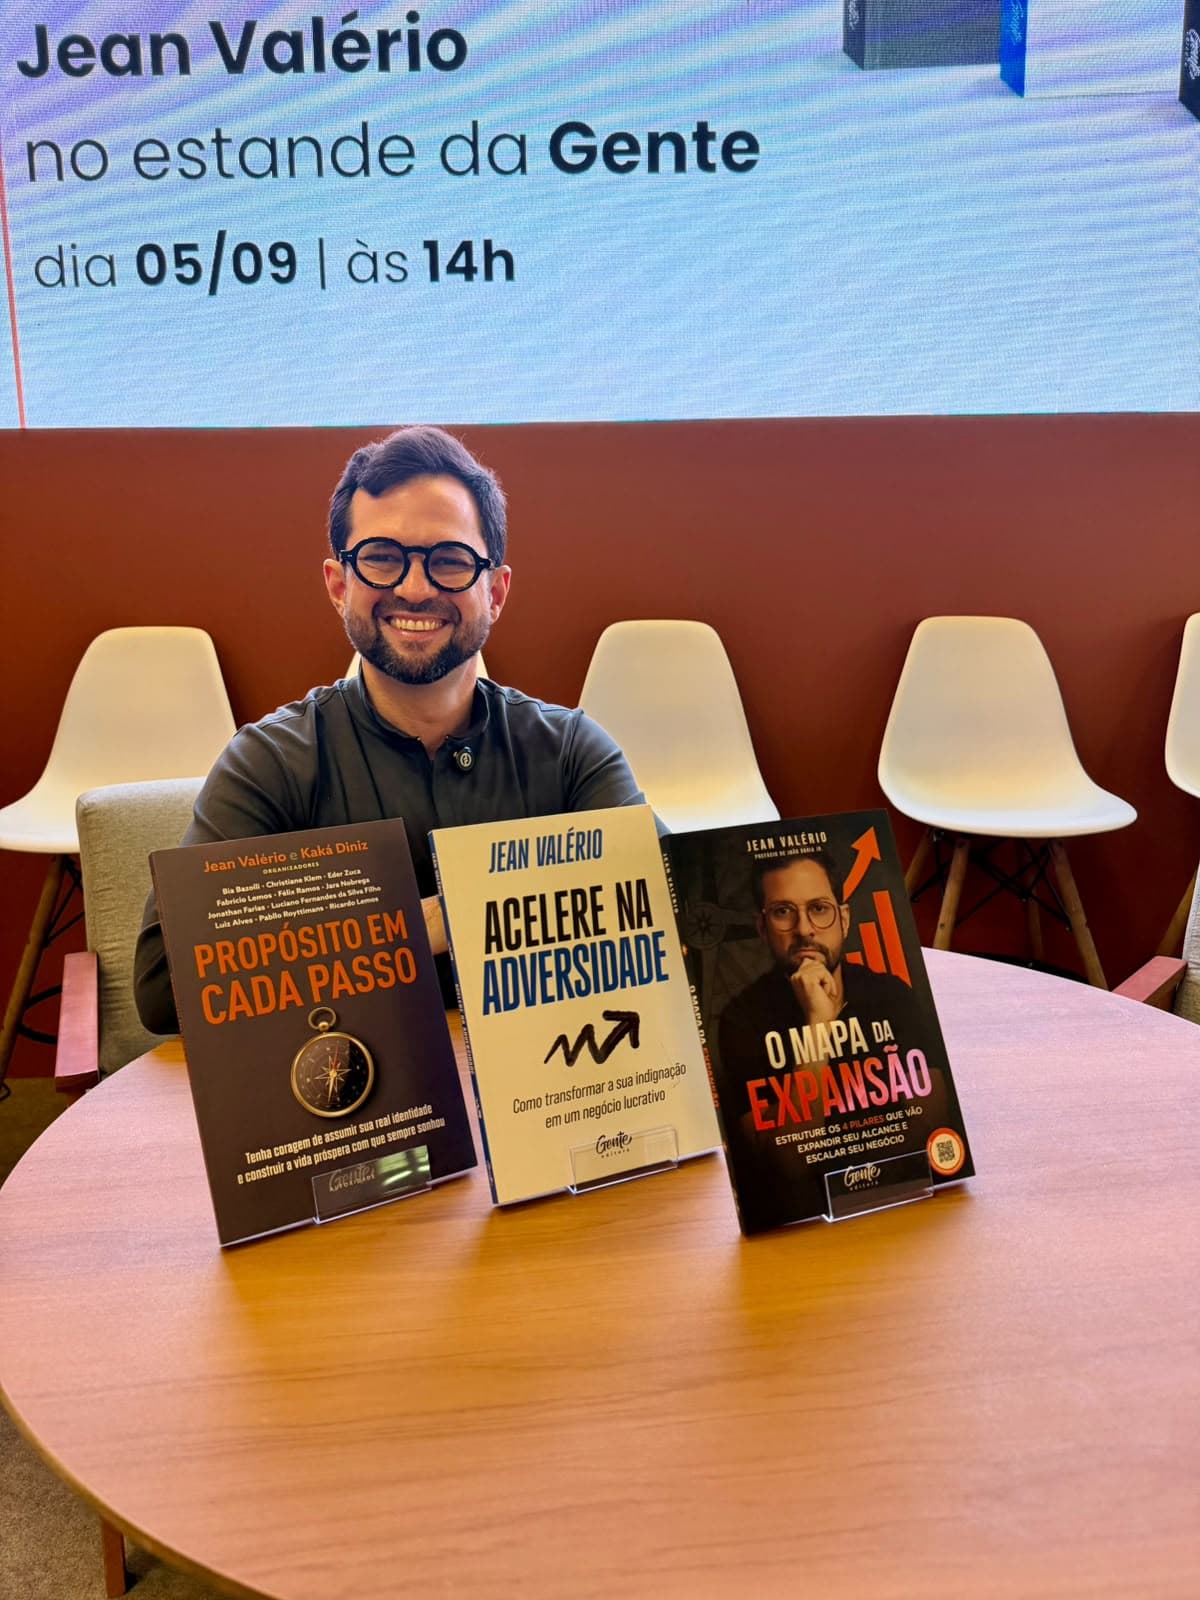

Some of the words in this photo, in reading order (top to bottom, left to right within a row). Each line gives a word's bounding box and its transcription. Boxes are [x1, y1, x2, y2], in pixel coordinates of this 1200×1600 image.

[17, 23, 191, 78] Jean
[209, 10, 468, 74] Valério
[26, 137, 109, 182] no
[133, 121, 416, 181] estande
[440, 120, 529, 176] da
[549, 120, 761, 175] Gente
[34, 245, 117, 289] dia
[136, 229, 297, 296] 05/09
[347, 240, 408, 284] às
[423, 240, 516, 284] 14h
[204, 861, 236, 873] Jean
[237, 851, 287, 868] Valério
[289, 852, 298, 861] e
[300, 844, 334, 859] Kaká
[335, 840, 369, 854] Diniz
[489, 838, 529, 874] JEAN
[536, 827, 602, 867] VALÉRIO
[747, 838, 775, 852] JEAN
[779, 832, 827, 847] VALÉRIO
[262, 861, 320, 875] ORGANIZADORES
[208, 908, 243, 919] Jonathan
[243, 904, 266, 914] Farias
[271, 899, 300, 909] Luciano
[300, 893, 337, 905] Fernandes
[232, 918, 254, 926] Alves
[329, 901, 355, 910] Ricardo
[247, 893, 272, 902] Lemos
[484, 885, 607, 955] ACELERE
[616, 878, 654, 932] NA
[194, 917, 363, 979] PROPÓSITO
[367, 910, 409, 945] EM
[201, 970, 304, 1025] CADA
[307, 947, 418, 1003] PASSO
[482, 931, 669, 1016] ADVERSIDADE
[765, 1031, 787, 1069] O
[791, 1016, 870, 1066] MAPA
[872, 1019, 895, 1044] DA
[513, 1097, 542, 1114] Como
[545, 1081, 605, 1106] transformar
[608, 1081, 614, 1092] a
[616, 1076, 633, 1089] sua
[635, 1063, 687, 1085] indignação
[545, 1115, 562, 1128] em
[564, 1110, 580, 1124] um
[583, 1100, 621, 1119] negócio
[624, 1090, 666, 1110] lucrativo
[746, 1044, 932, 1131] EXPANSÃO
[245, 1148, 273, 1164] Tenha
[273, 1138, 311, 1154] coragem
[312, 1134, 324, 1146] de
[324, 1124, 358, 1143] assumir
[358, 1120, 375, 1133] sua
[375, 1114, 392, 1129] real
[391, 1103, 433, 1124] identidade
[596, 1131, 633, 1155] Gente
[775, 1126, 827, 1146] ESTRUTURE
[828, 1123, 841, 1134] OS
[842, 1122, 849, 1130] 4
[849, 1114, 885, 1129] PILARES
[886, 1111, 904, 1122] QUE
[905, 1105, 923, 1117] VÃO
[797, 1136, 842, 1154] EXPANDIR
[842, 1132, 860, 1144] SEU
[861, 1124, 900, 1140] ALCANCE
[901, 1121, 909, 1130] E
[237, 1173, 244, 1185] e
[245, 1161, 285, 1182] construir
[286, 1160, 293, 1171] a
[293, 1154, 313, 1169] vida
[313, 1144, 351, 1165] próspera
[351, 1139, 370, 1153] com
[370, 1134, 387, 1147] que
[386, 1125, 417, 1142] sempre
[416, 1117, 446, 1133] sonhou
[805, 1148, 847, 1165] ESCALAR
[847, 1143, 865, 1155] SEU
[866, 1134, 905, 1151] NEGÓCIO
[844, 1162, 881, 1187] Gente
